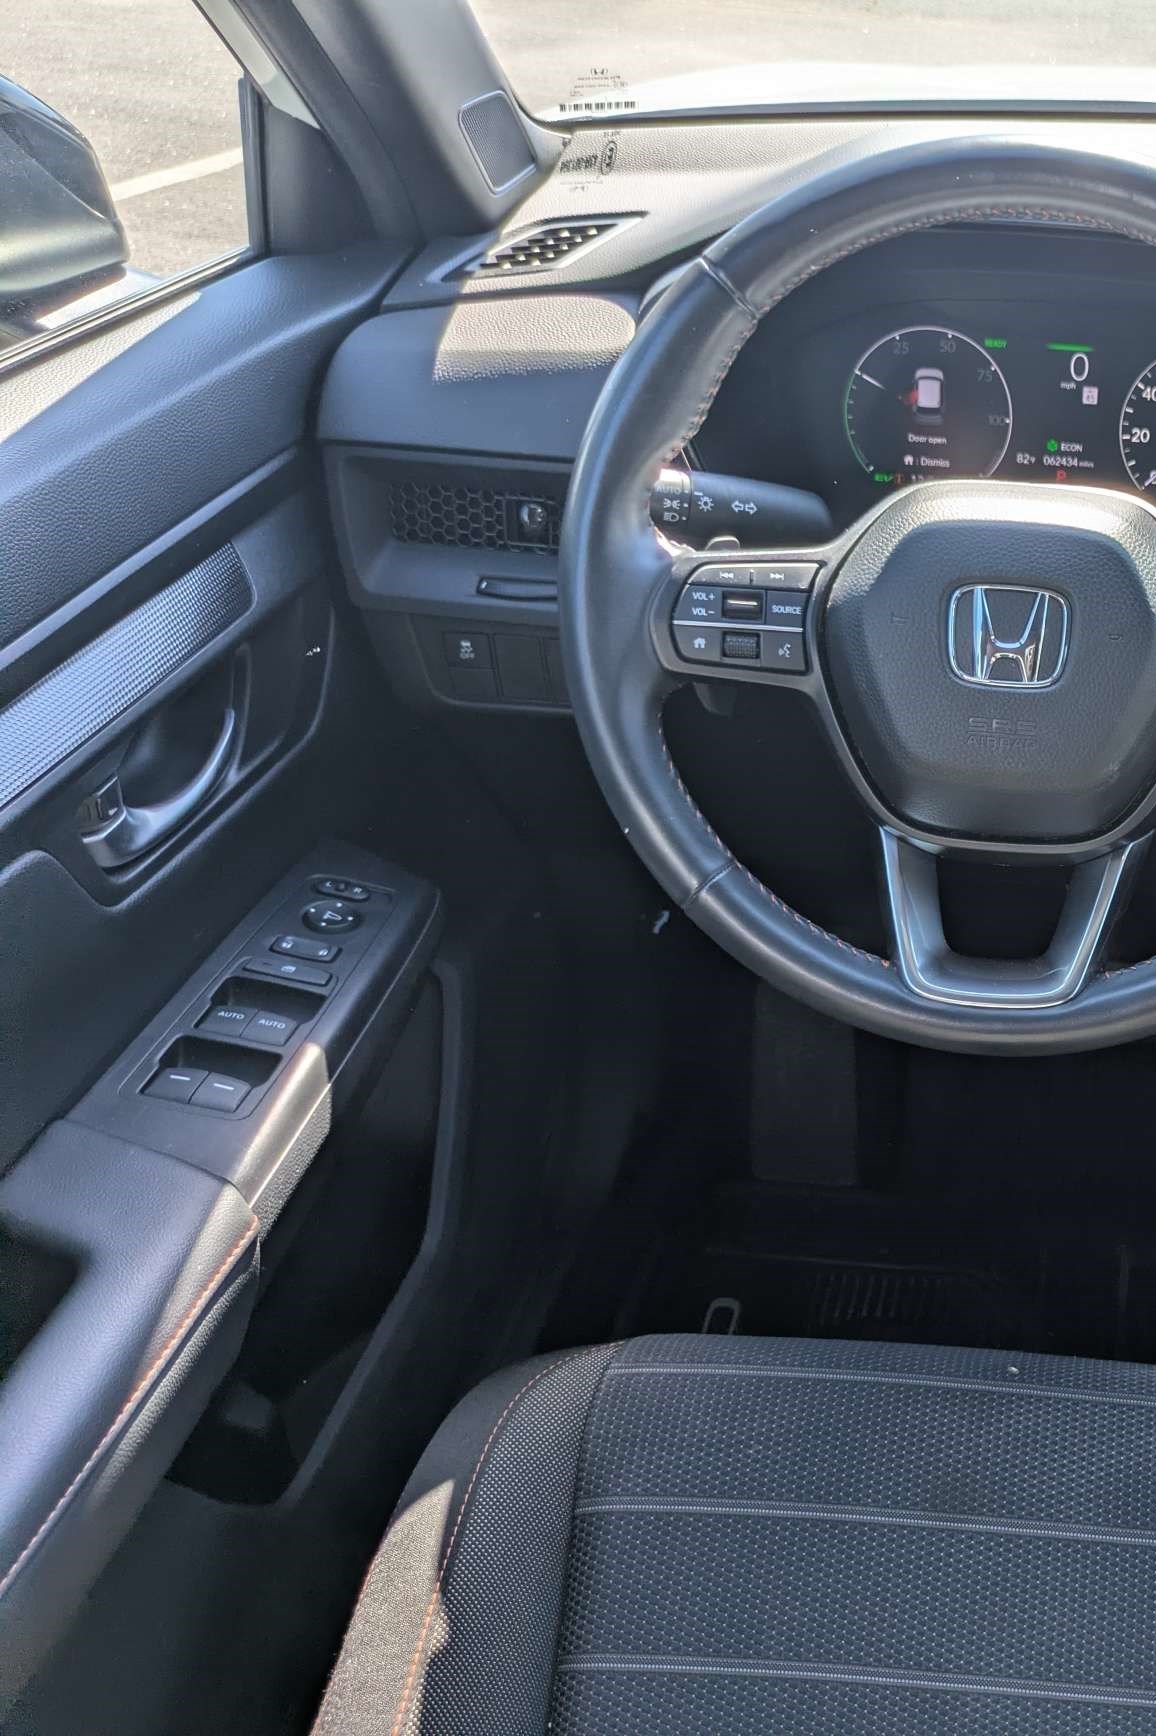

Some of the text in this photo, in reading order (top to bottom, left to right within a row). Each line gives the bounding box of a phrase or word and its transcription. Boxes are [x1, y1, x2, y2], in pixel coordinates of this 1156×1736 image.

[1070, 352, 1089, 381] 0
[908, 434, 948, 446] Door open
[1131, 428, 1150, 443] 20
[1060, 441, 1083, 453] ECON
[920, 456, 950, 469] Dismiss
[1043, 455, 1078, 468] 062434
[772, 604, 803, 615] SOURCE
[218, 1009, 245, 1021] AUTO
[257, 1018, 285, 1030] AUTO
